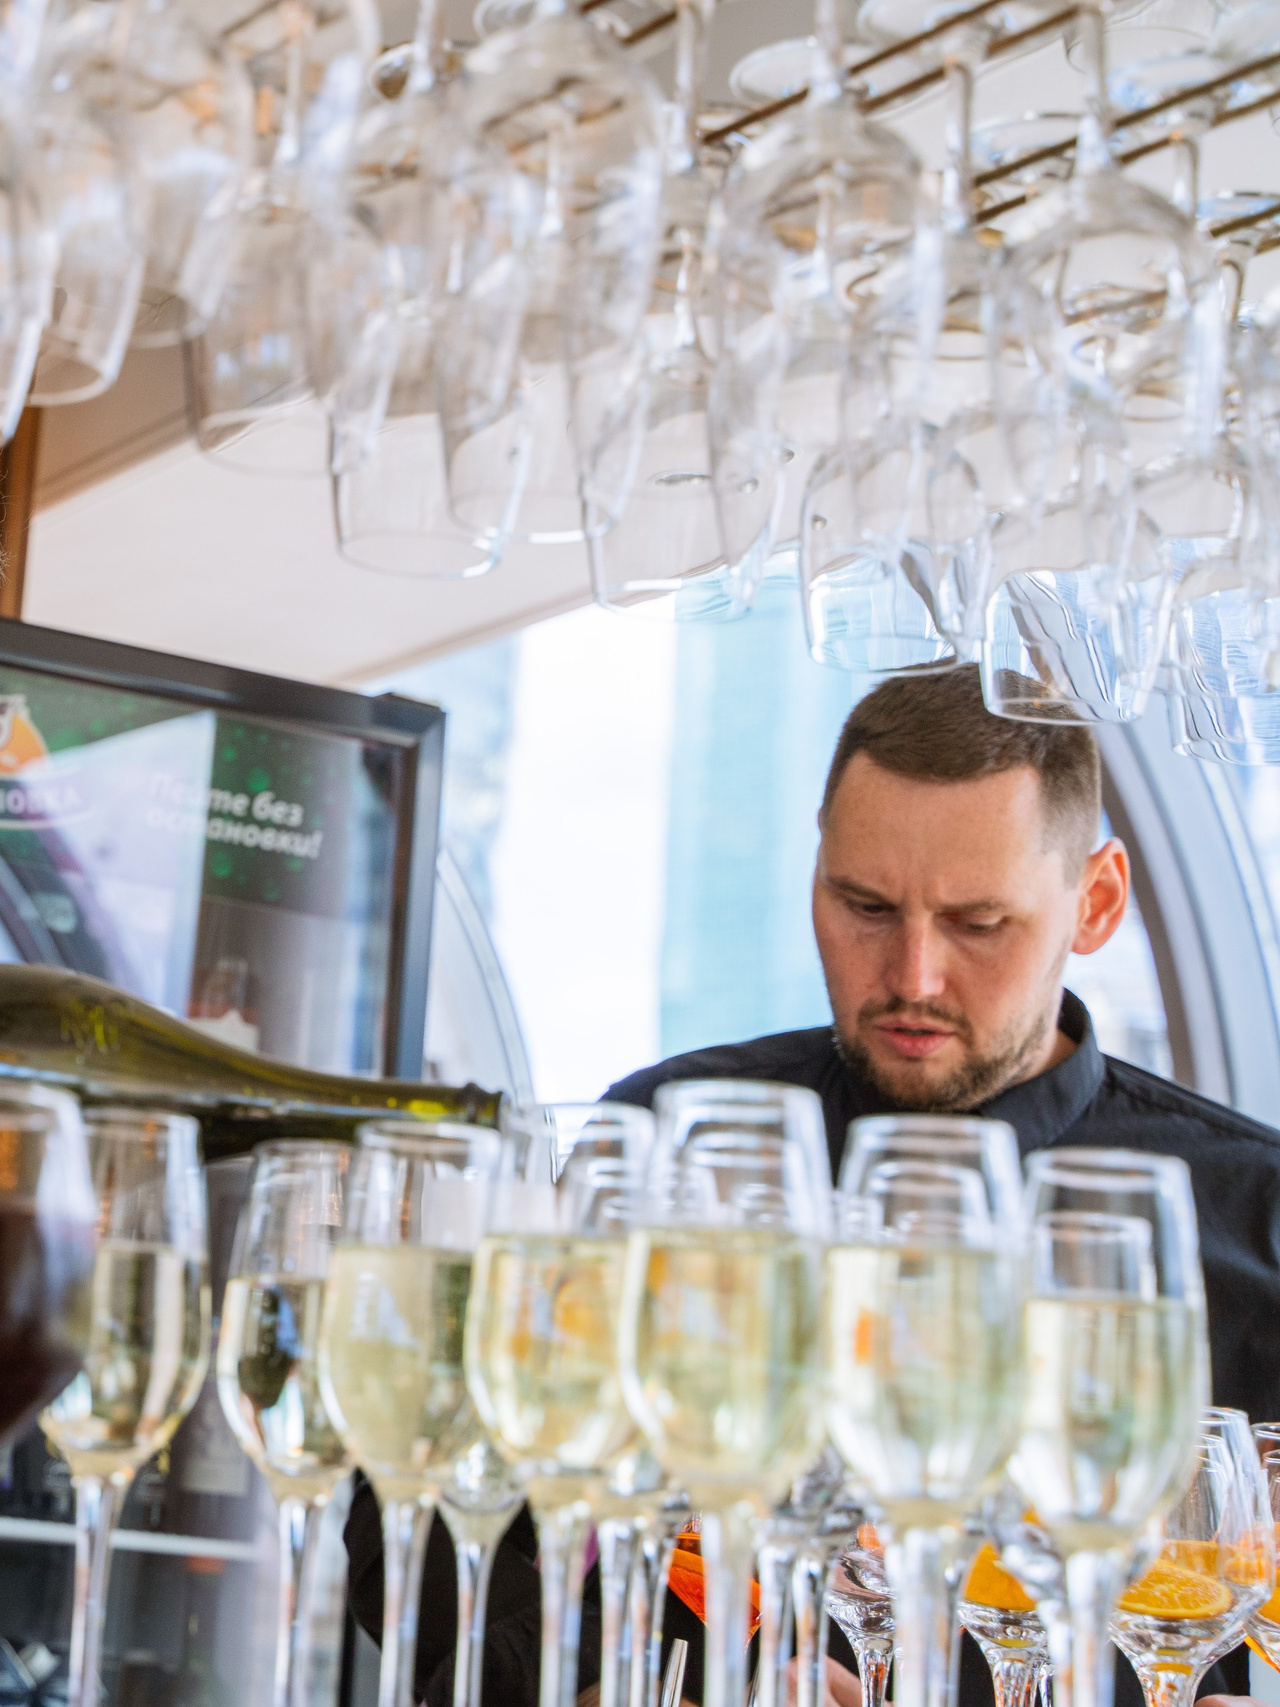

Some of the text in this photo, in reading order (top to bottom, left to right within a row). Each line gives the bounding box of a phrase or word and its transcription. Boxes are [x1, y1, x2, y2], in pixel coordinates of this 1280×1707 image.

[148, 772, 305, 828] Пете без
[145, 806, 324, 860] осановки!
